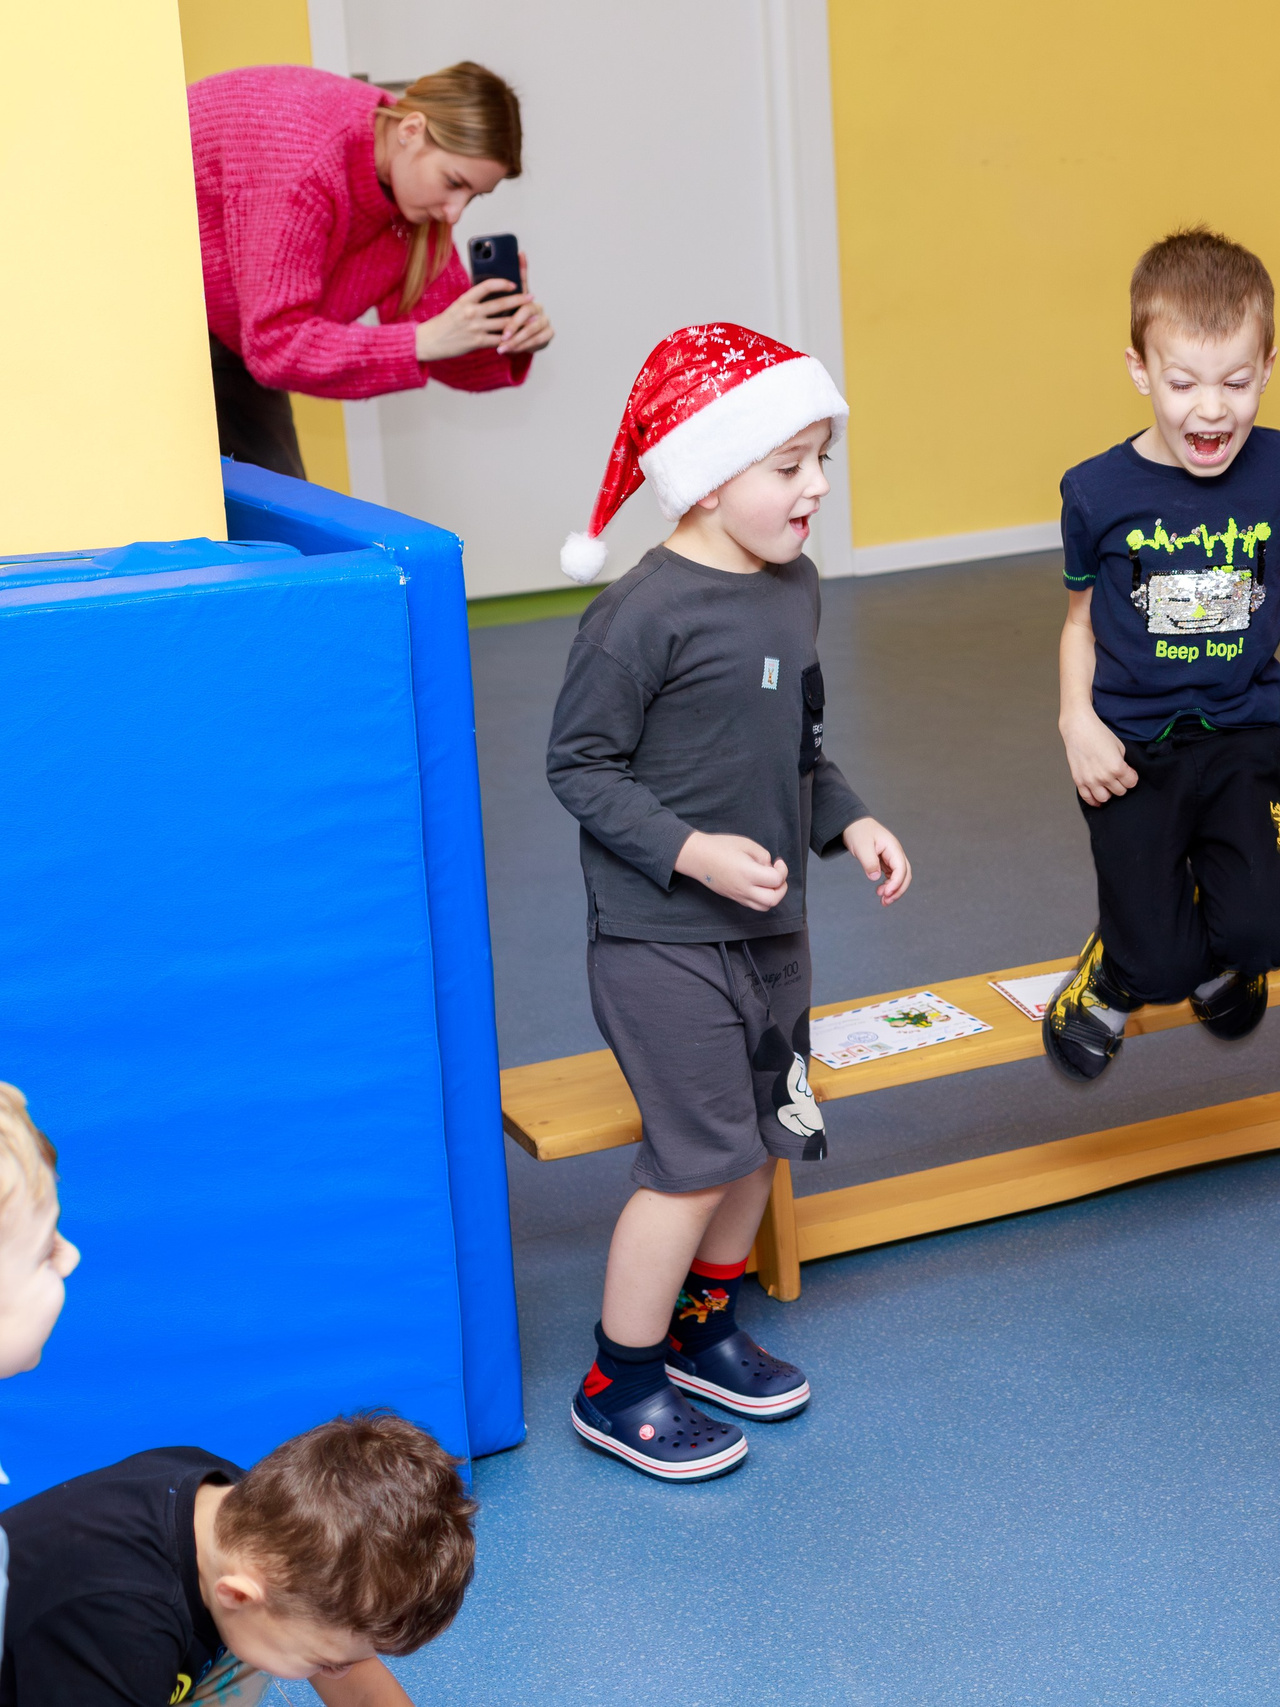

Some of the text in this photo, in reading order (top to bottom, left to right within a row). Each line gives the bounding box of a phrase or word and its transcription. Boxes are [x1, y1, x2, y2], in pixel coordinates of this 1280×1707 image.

[1155, 637, 1244, 663] Beep bop!
[782, 960, 799, 979] 100
